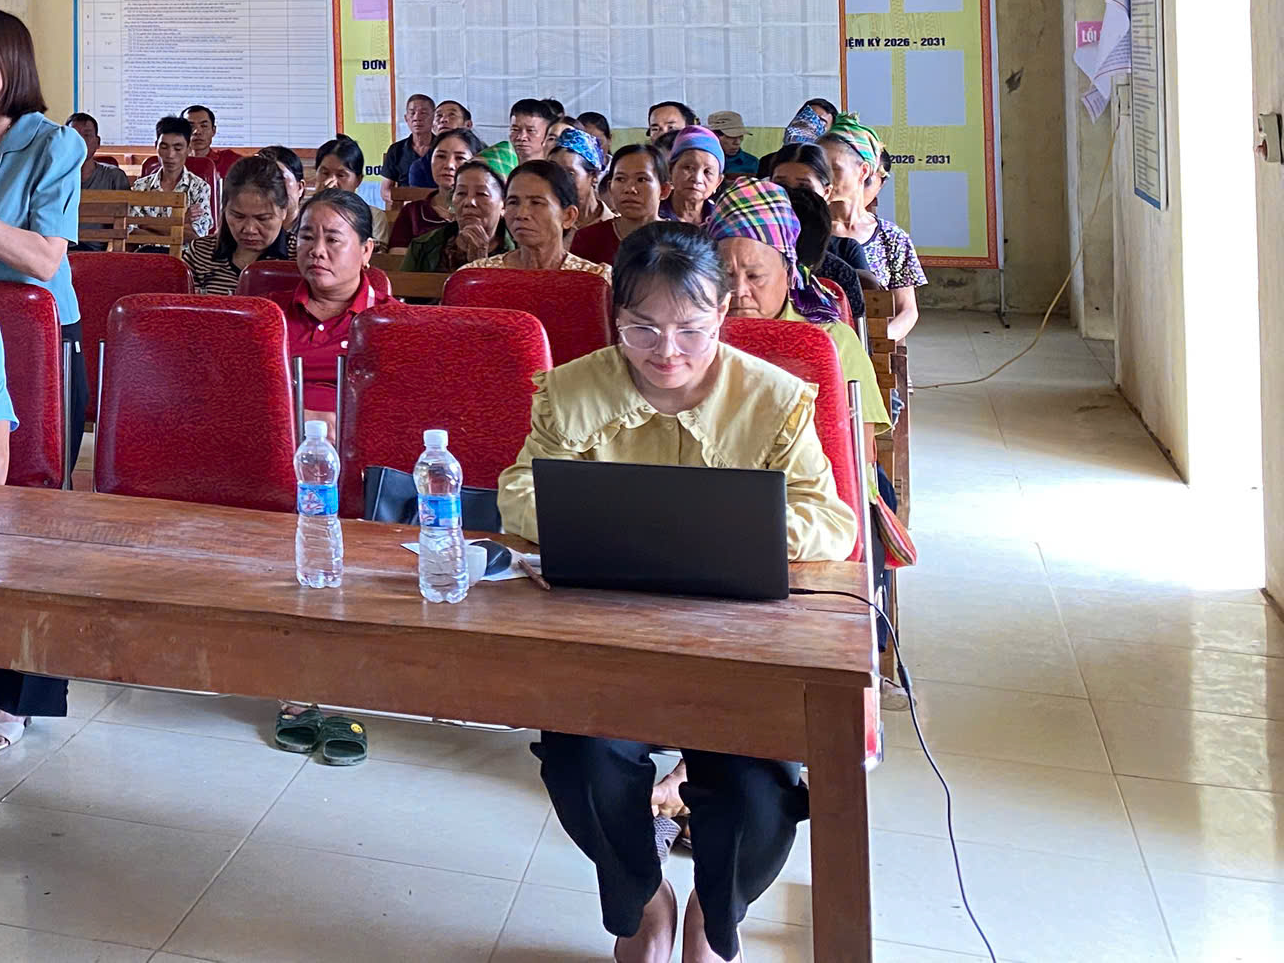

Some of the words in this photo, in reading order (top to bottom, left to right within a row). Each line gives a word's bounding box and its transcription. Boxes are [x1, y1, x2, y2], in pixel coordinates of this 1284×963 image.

[884, 38, 910, 47] 2026
[920, 37, 946, 46] 2031
[362, 60, 386, 70] ĐƠN
[890, 155, 915, 164] 2026
[926, 155, 951, 164] 2031
